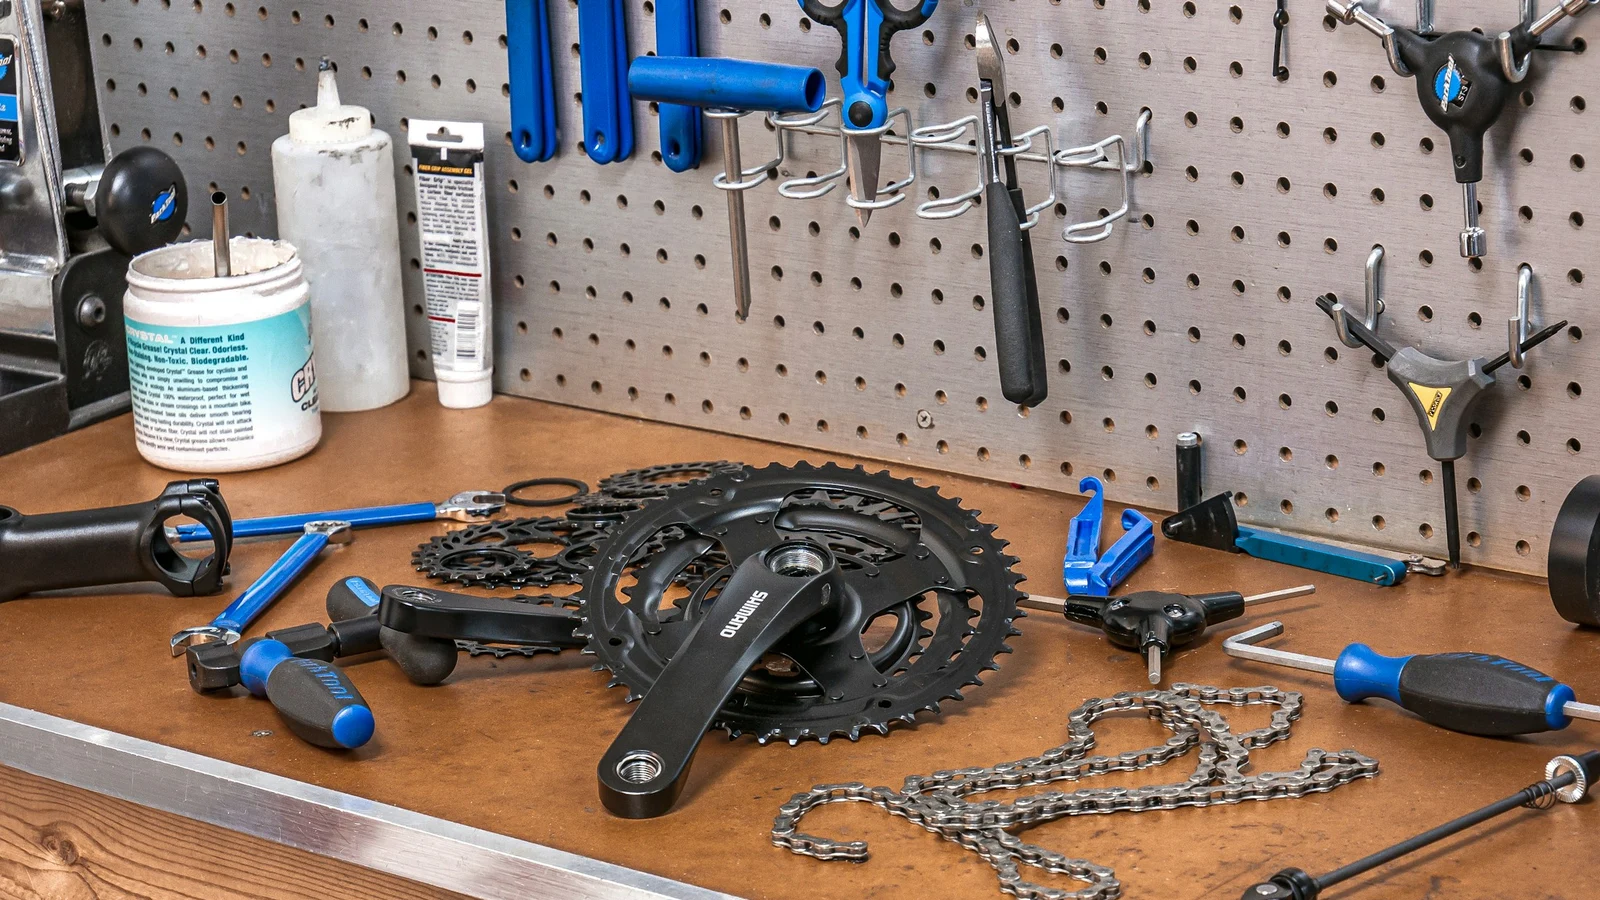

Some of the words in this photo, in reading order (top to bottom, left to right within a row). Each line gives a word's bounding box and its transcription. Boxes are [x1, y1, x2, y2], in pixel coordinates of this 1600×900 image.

[190, 335, 223, 345] Different
[227, 333, 245, 342] Kind
[163, 346, 188, 356] Crystal
[190, 347, 211, 355] Clear.
[212, 344, 248, 353] Odorless.
[191, 354, 249, 366] Biodegradable.
[216, 366, 236, 374] cyclists
[720, 590, 769, 638] SHIMANO
